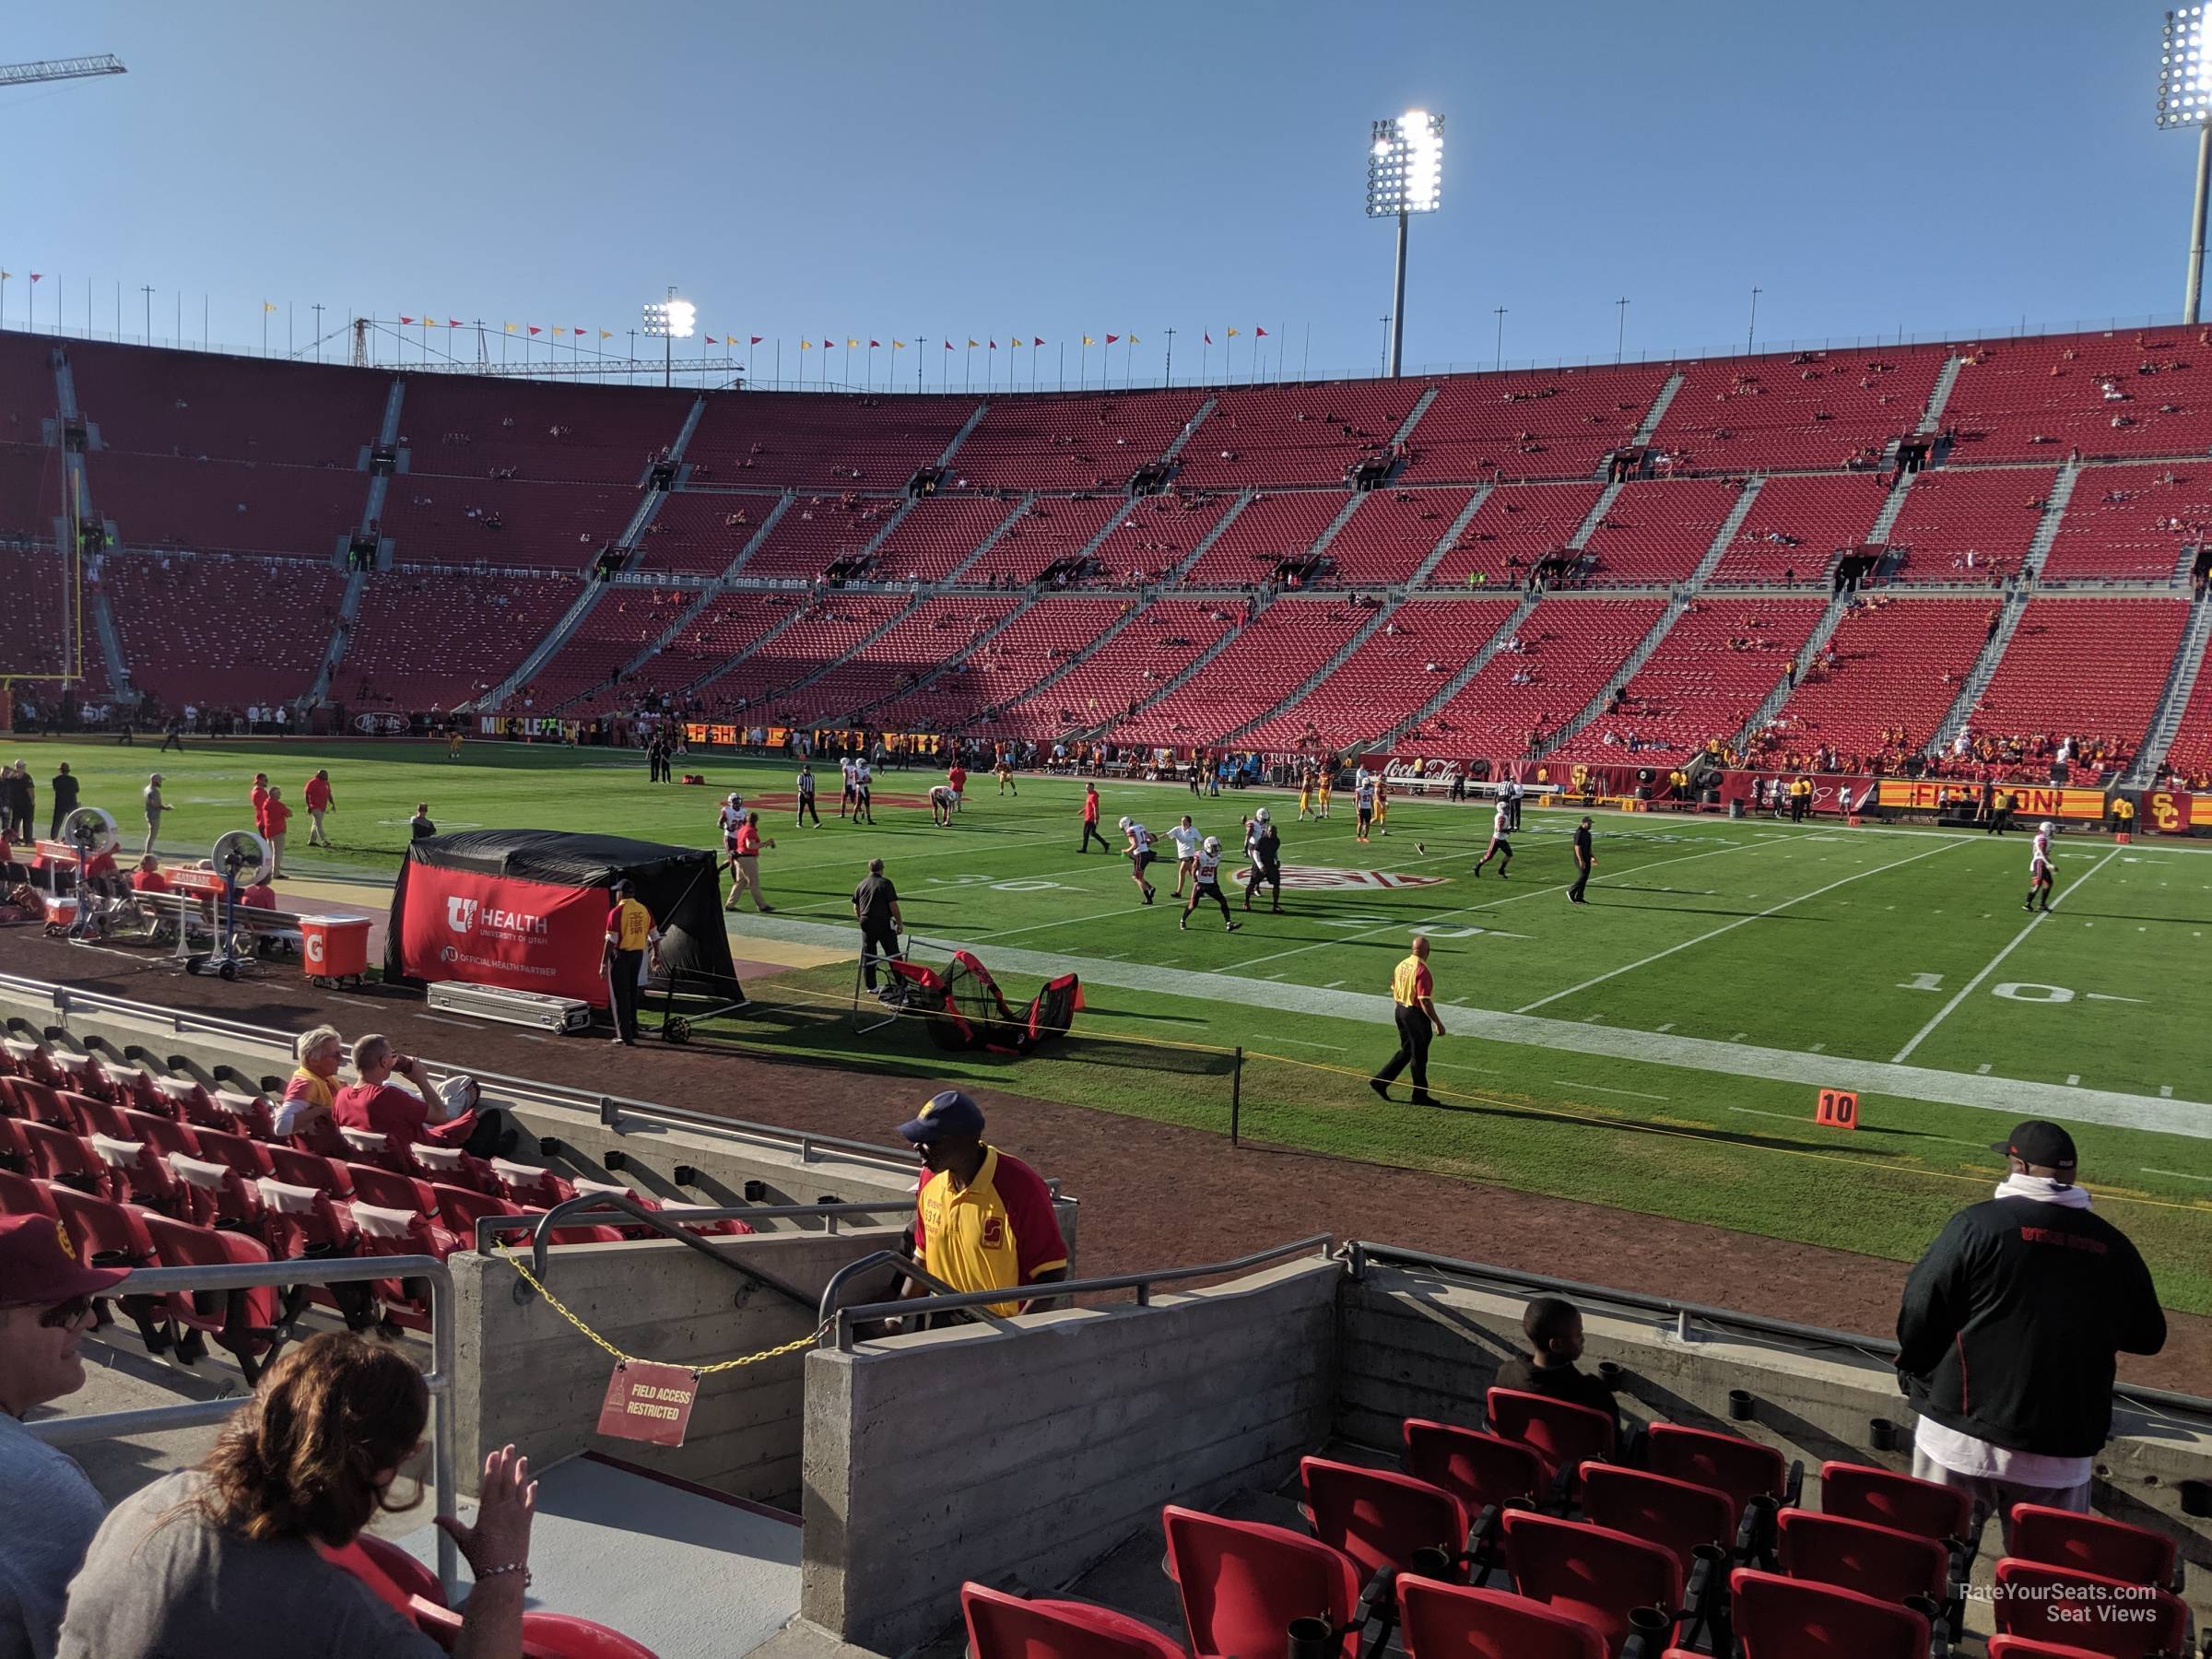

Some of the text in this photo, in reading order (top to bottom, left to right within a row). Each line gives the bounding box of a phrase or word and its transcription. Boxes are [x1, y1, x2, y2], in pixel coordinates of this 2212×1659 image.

[1383, 758, 1459, 781] CocaCola
[176, 872, 211, 886] GATORADE
[480, 908, 548, 934] HEALTH
[306, 934, 324, 962] G
[480, 928, 548, 945] UNIVERSITY OF UTAH
[460, 953, 491, 966] OFFICIAL
[492, 960, 521, 972] HEALTH
[521, 965, 557, 977] PARTNER
[1823, 1093, 1853, 1124] 10
[631, 1383, 691, 1405] FIELD ACCESS
[627, 1401, 679, 1421] RESTRICTED
